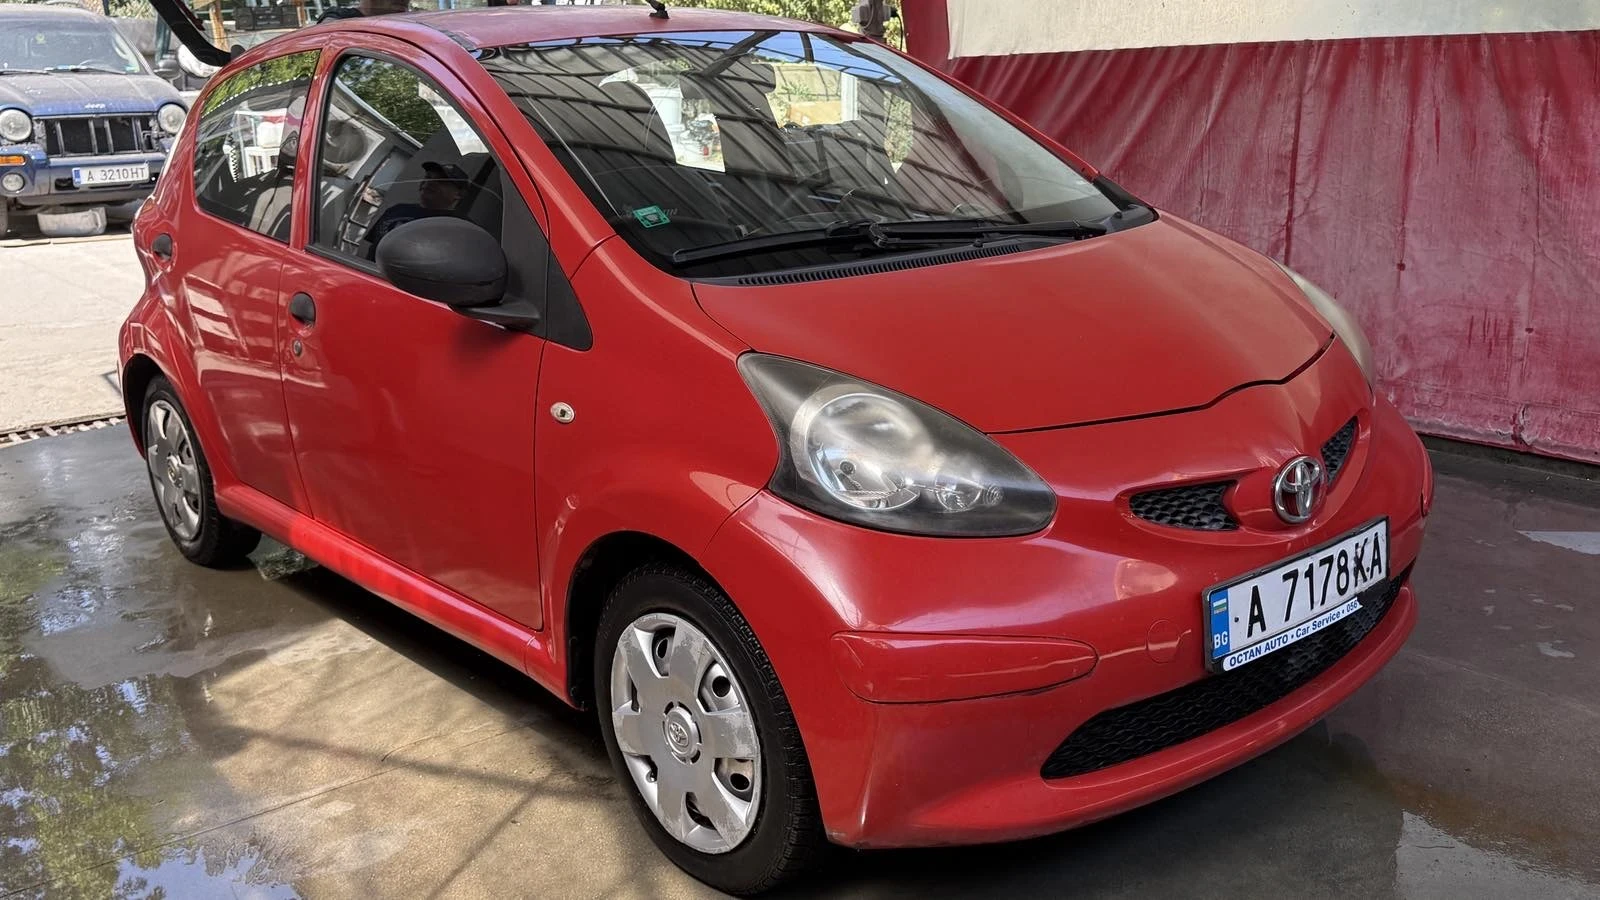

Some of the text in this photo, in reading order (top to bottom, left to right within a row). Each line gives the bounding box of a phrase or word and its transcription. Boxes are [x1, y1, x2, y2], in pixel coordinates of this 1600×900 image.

[87, 170, 95, 182] A
[1247, 585, 1266, 638] A
[1214, 631, 1228, 649] BG
[1230, 646, 1261, 667] OCTAN
[1264, 634, 1288, 653] AUTO
[1296, 626, 1310, 638] Car
[1312, 609, 1340, 630] Service
